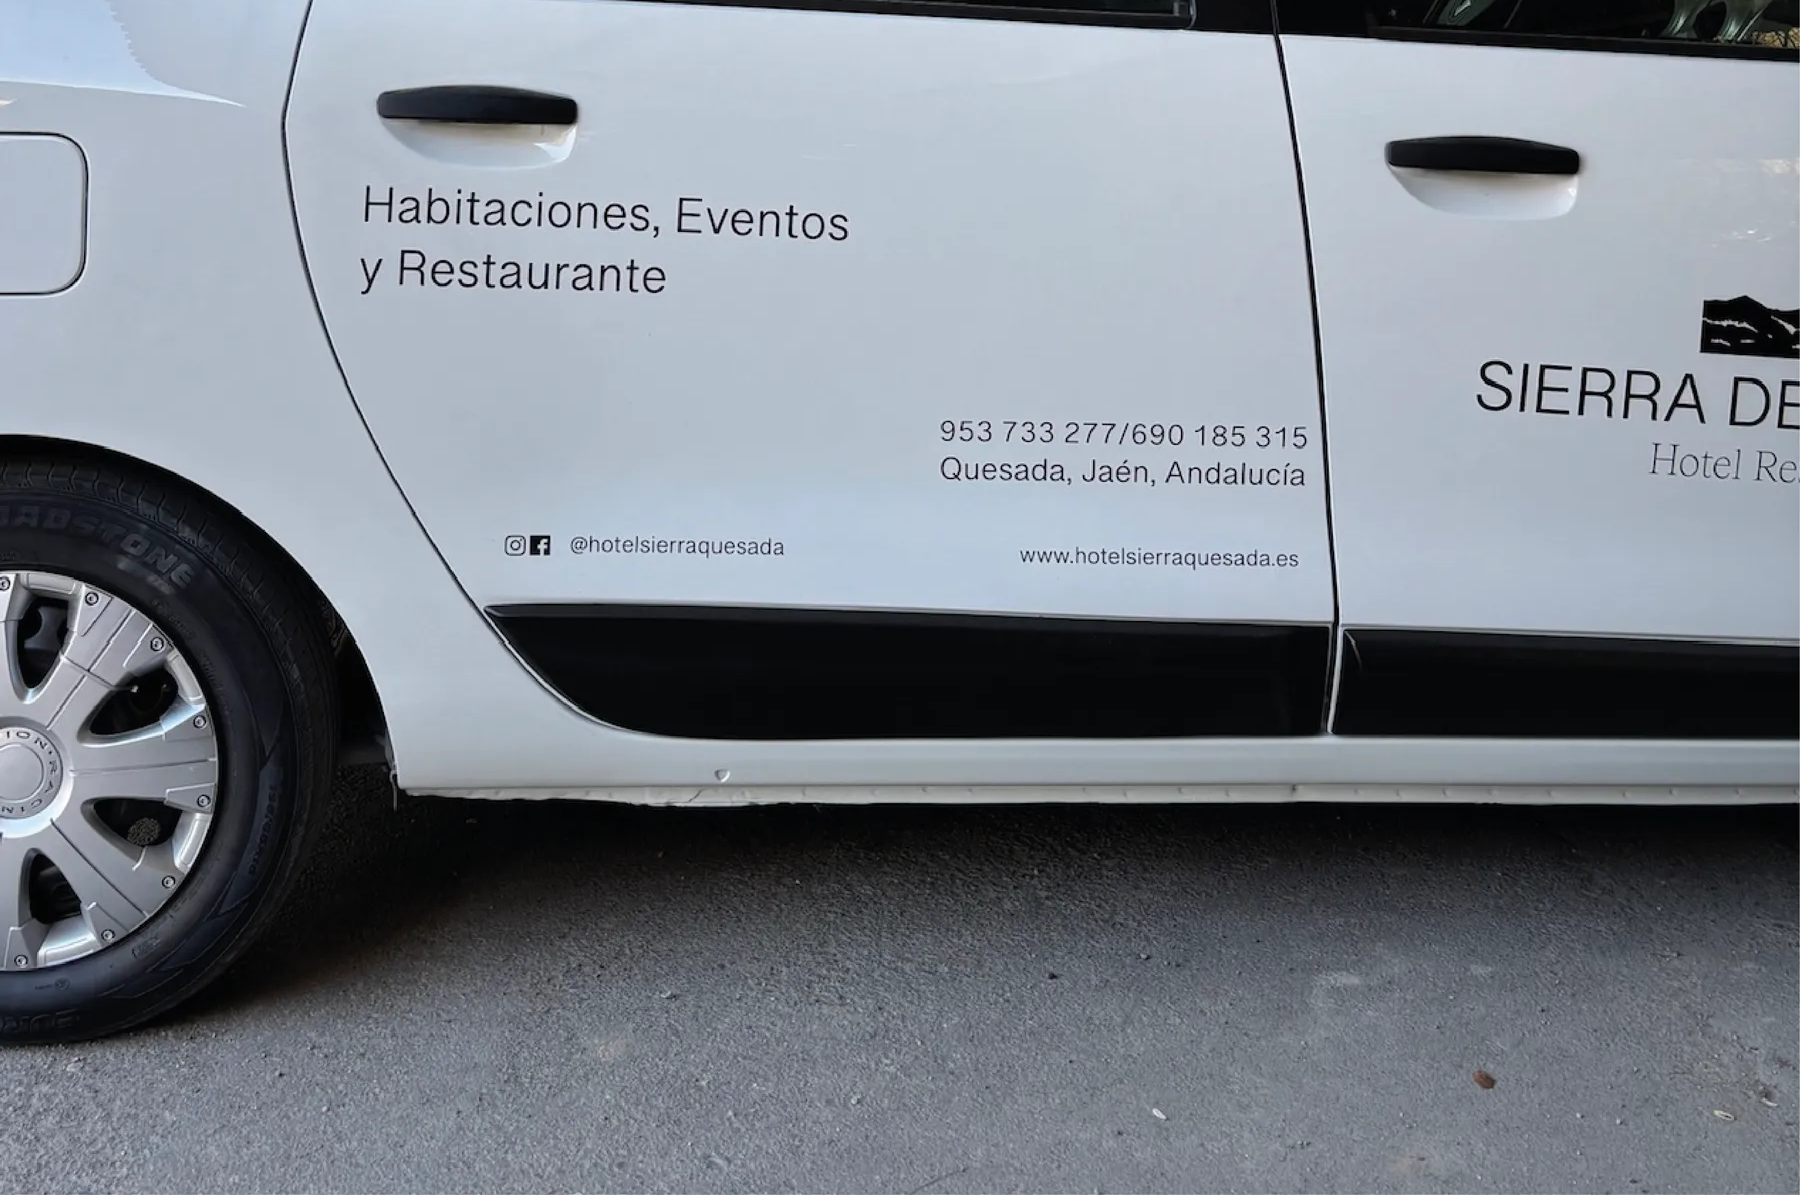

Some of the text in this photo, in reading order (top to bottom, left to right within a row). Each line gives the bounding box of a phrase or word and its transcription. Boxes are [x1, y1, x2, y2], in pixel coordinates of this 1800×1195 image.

[363, 184, 850, 242] Habitaciones, Eventos
[359, 249, 667, 296] y Restaurante
[1476, 360, 1799, 430] SIERRA DE
[940, 419, 1308, 450] 953 733 277/690 185 315
[940, 456, 1306, 488] Quesada, Jaén, Andalucía
[1648, 441, 1799, 484] Hotel Re
[569, 535, 785, 559] @hotelsierraquesada
[1019, 546, 1300, 571] www.hotelsierraquesada.es
